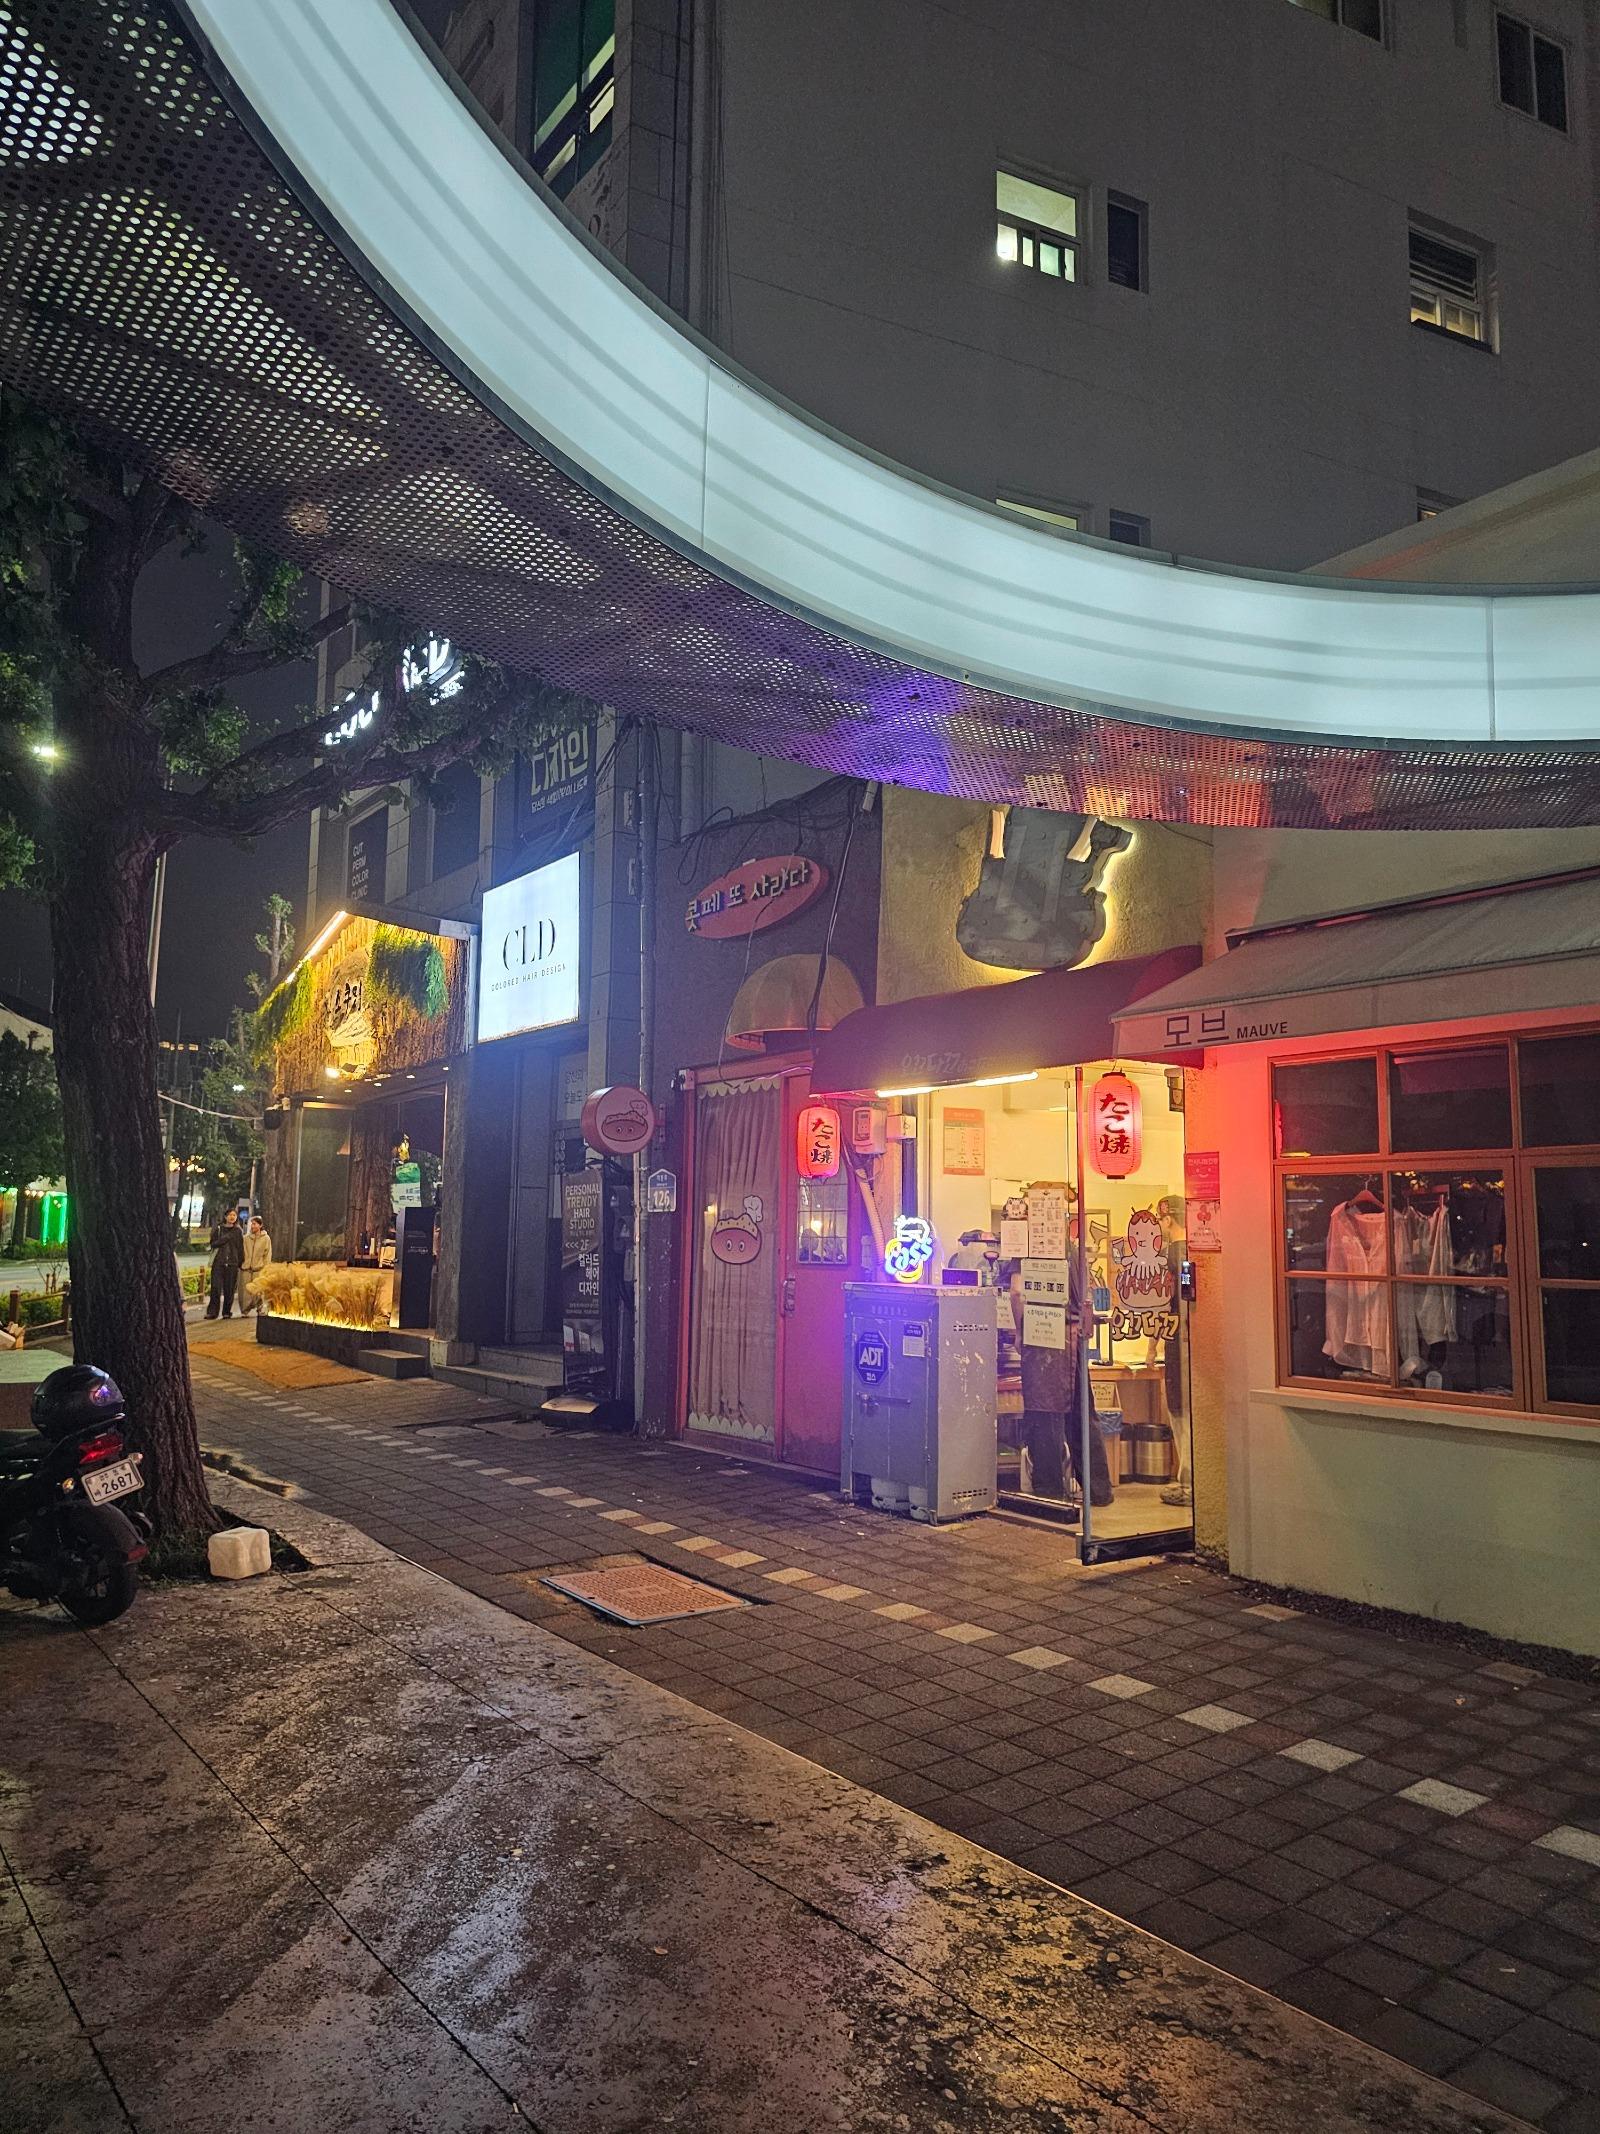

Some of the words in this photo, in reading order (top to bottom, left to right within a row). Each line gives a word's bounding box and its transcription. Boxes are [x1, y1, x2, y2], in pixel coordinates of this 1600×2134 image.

[531, 726, 589, 796] 디자인
[352, 842, 364, 857] CUT
[351, 869, 369, 887] COLOR
[685, 890, 720, 932] 콧페
[726, 883, 743, 908] 또
[502, 918, 556, 971] CLD
[491, 977, 519, 992] COLORED
[523, 971, 538, 983] HAIR
[541, 963, 566, 977] DESIGN
[1163, 1010, 1229, 1048] 모브
[1236, 1021, 1288, 1039] MAUVE
[1099, 1092, 1132, 1154] たこ焼
[810, 1117, 834, 1165] たこ焼
[565, 1183, 600, 1196] PERSONAL
[653, 1190, 670, 1206] 126
[566, 1195, 598, 1208] TRENDY
[573, 1207, 590, 1218] HAIR
[569, 1219, 595, 1230] STUDIO
[580, 1240, 589, 1251] 2F
[579, 1253, 599, 1268] 컬러드
[585, 1267, 599, 1281] 헤어
[578, 1281, 599, 1295] 디자인
[859, 1346, 884, 1367] ADT
[101, 1472, 133, 1494] 2687
